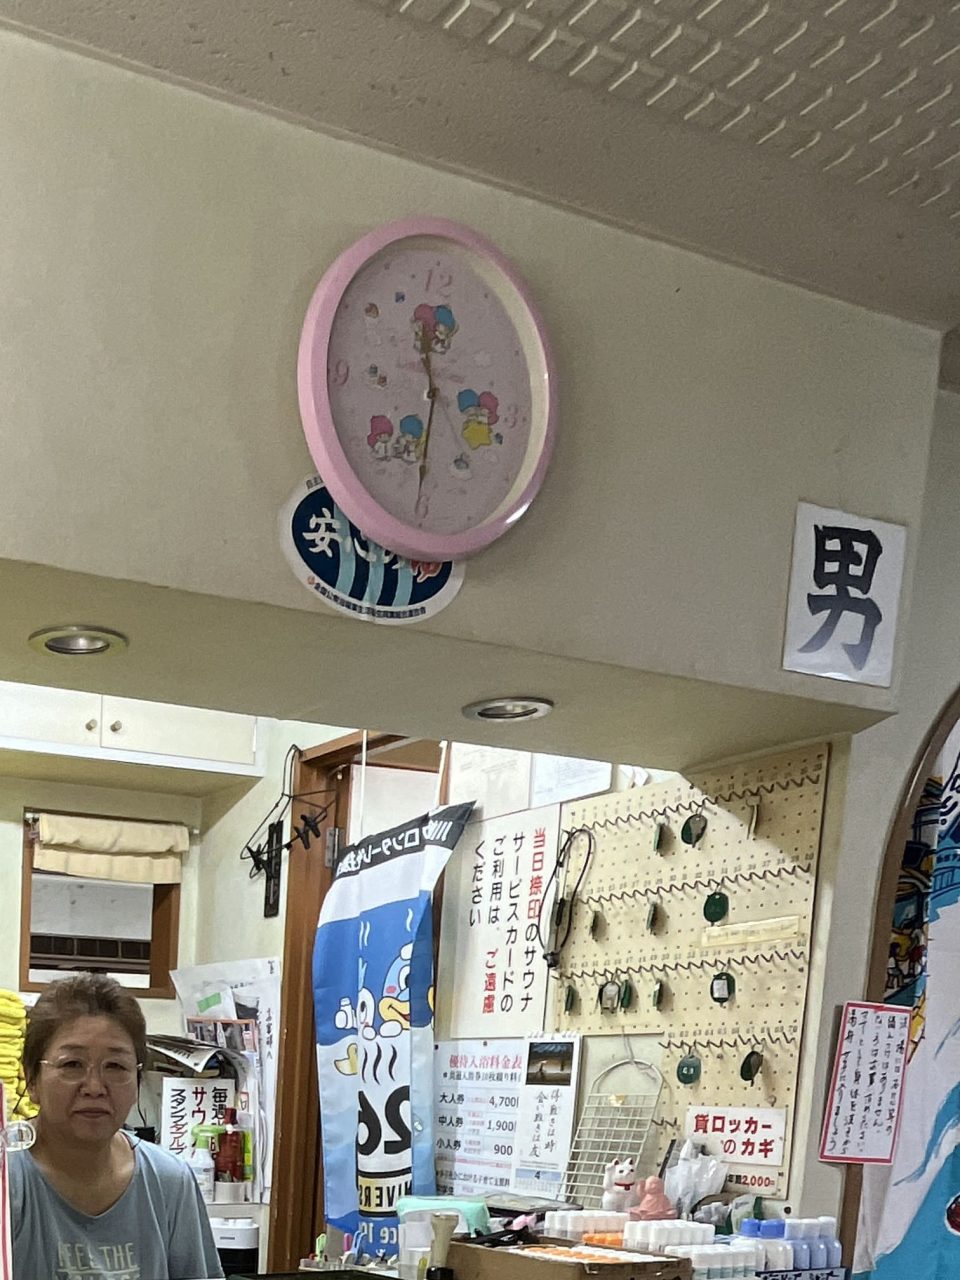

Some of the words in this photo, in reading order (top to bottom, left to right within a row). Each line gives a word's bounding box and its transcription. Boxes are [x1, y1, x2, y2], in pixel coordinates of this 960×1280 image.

[797, 523, 883, 671] 男
[470, 840, 486, 927] ください
[500, 832, 526, 1013] サービスカードの
[520, 827, 547, 1012] 当日捺印のサウナ
[482, 948, 499, 1014] ご遠慮
[449, 1054, 523, 1070] 優待入浴料金表
[439, 1093, 465, 1106] 大人券
[488, 1096, 519, 1108] 4,700
[438, 1115, 464, 1128] 中人券
[487, 1119, 517, 1132] 1,900
[693, 1113, 773, 1135] 貸ロッカー
[436, 1137, 461, 1151] 小人券
[722, 1137, 775, 1159] のカギ
[99, 1242, 138, 1270] THE
